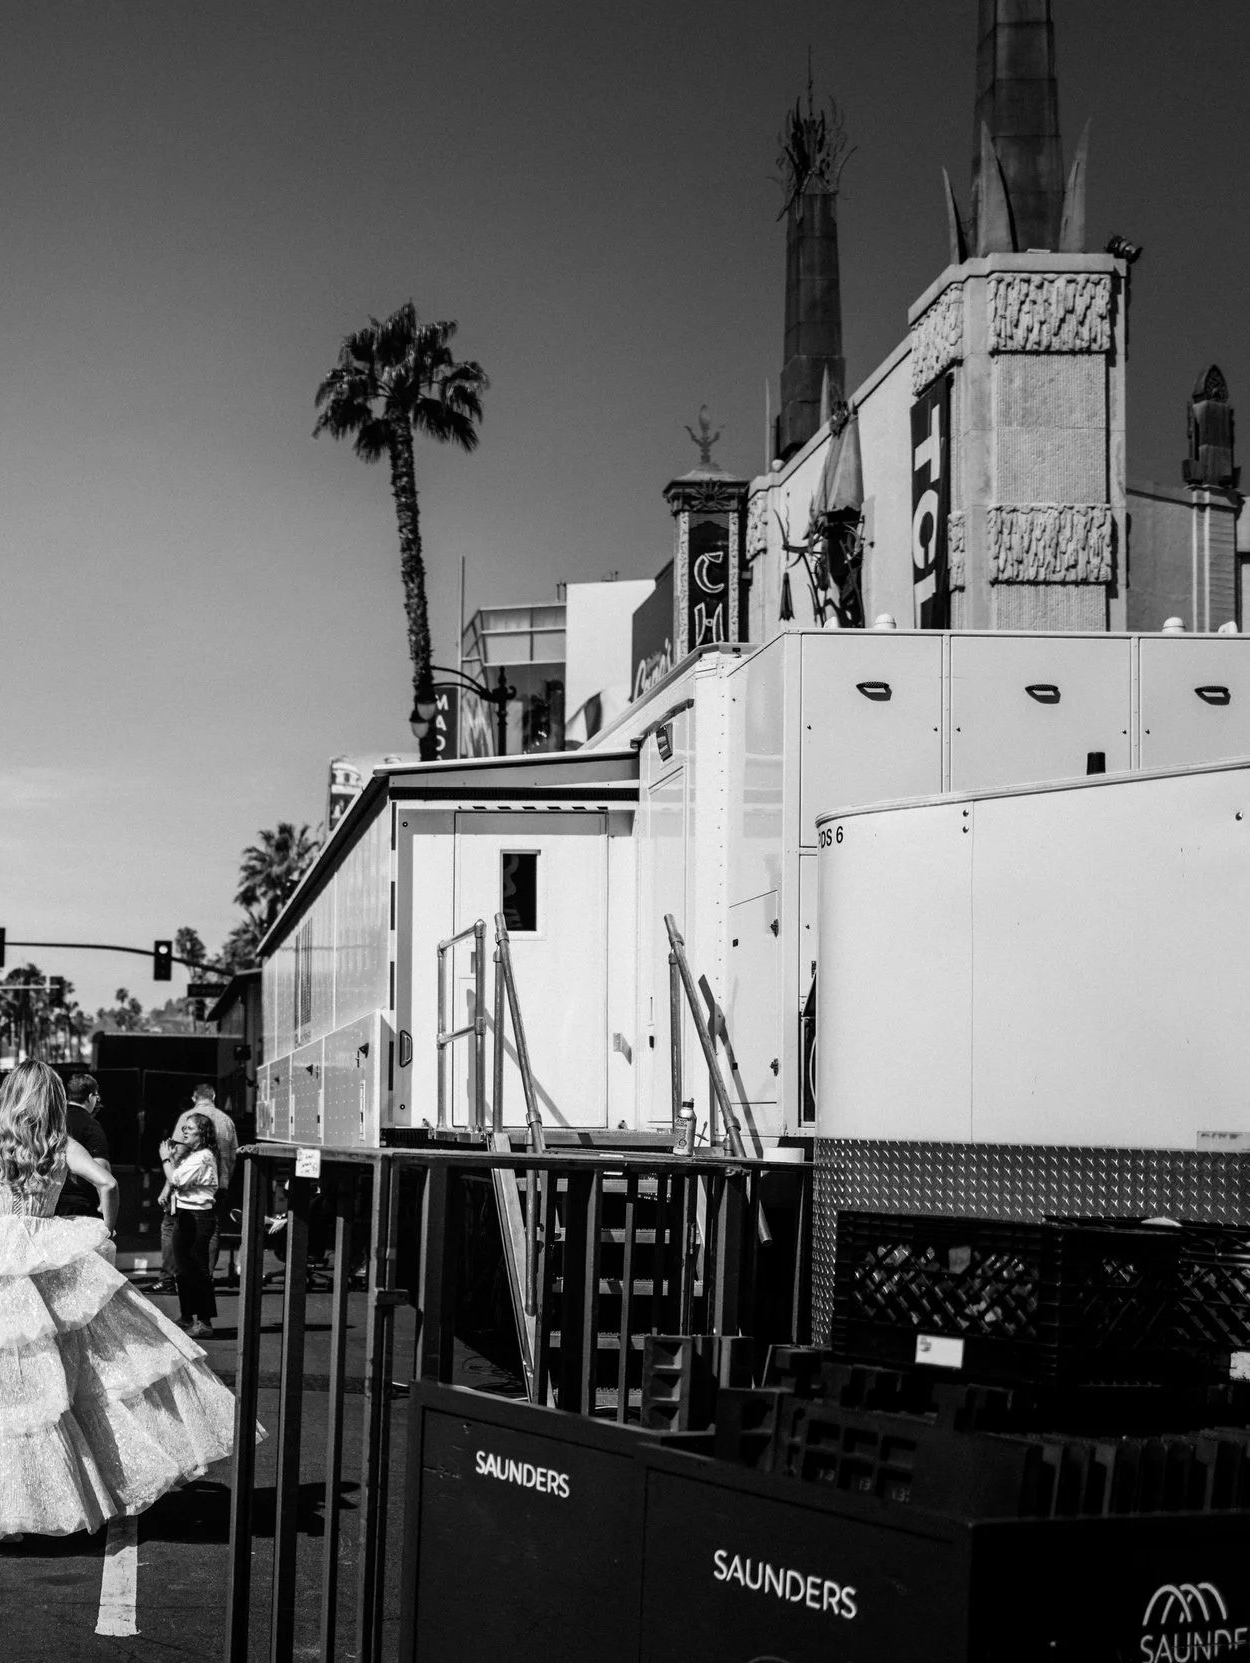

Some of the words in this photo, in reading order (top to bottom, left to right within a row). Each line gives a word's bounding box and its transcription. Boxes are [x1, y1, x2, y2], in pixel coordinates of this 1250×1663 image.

[836, 825, 844, 844] 6
[475, 1450, 570, 1498] SAUNDERS
[713, 1549, 858, 1620] SAUNDERS
